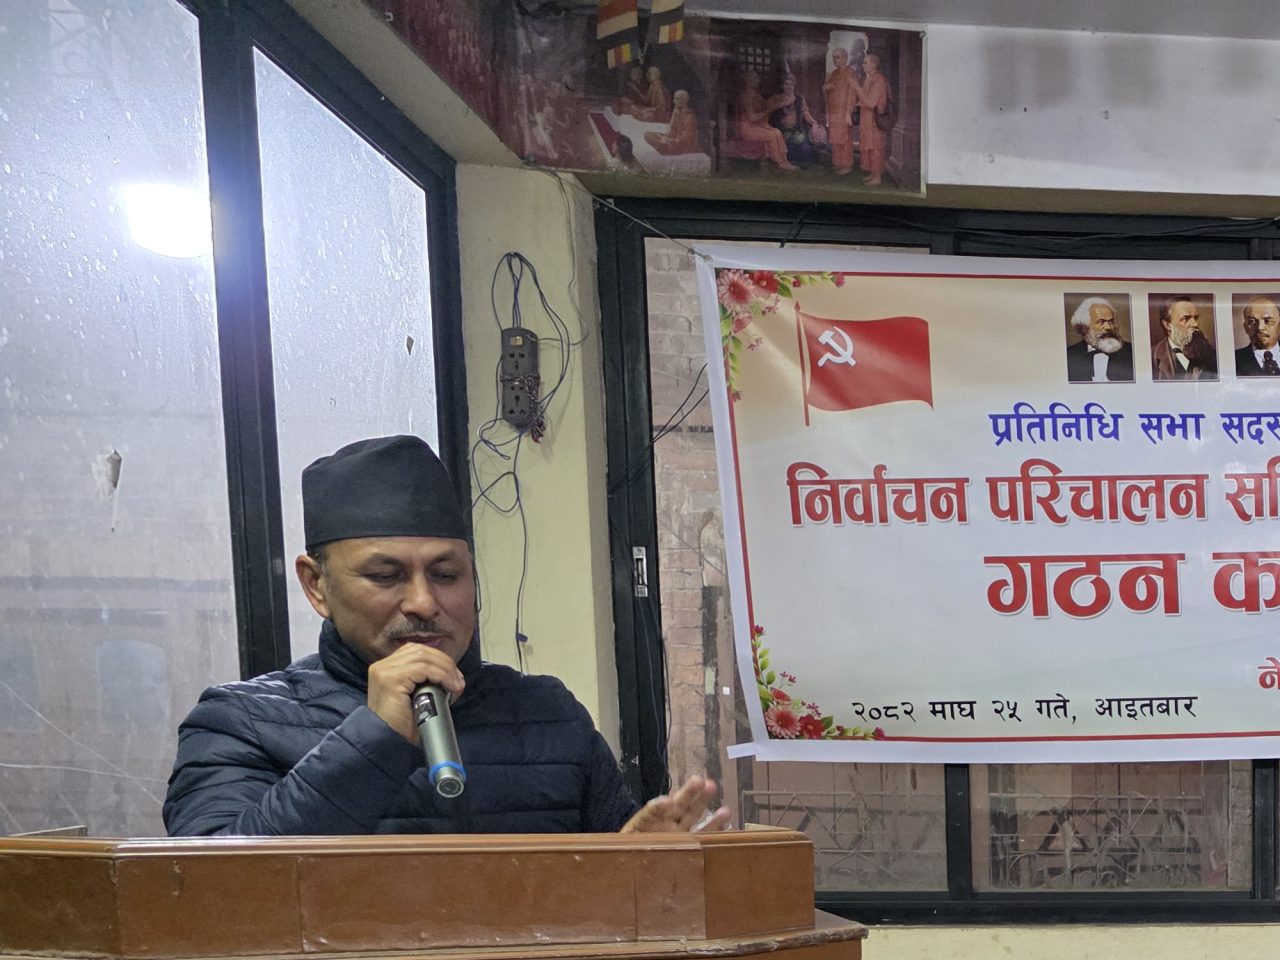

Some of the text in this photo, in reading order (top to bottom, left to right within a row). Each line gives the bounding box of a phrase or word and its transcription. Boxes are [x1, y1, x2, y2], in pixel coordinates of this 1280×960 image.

[988, 402, 1124, 446] प्रतिनिधि
[1138, 413, 1206, 445] सभा
[786, 461, 969, 526] निर्वाचन
[985, 458, 1209, 525] परिचालन
[983, 553, 1186, 620] गठन
[851, 693, 1199, 725] २०८२ माघ २५ गते, आइतबार
